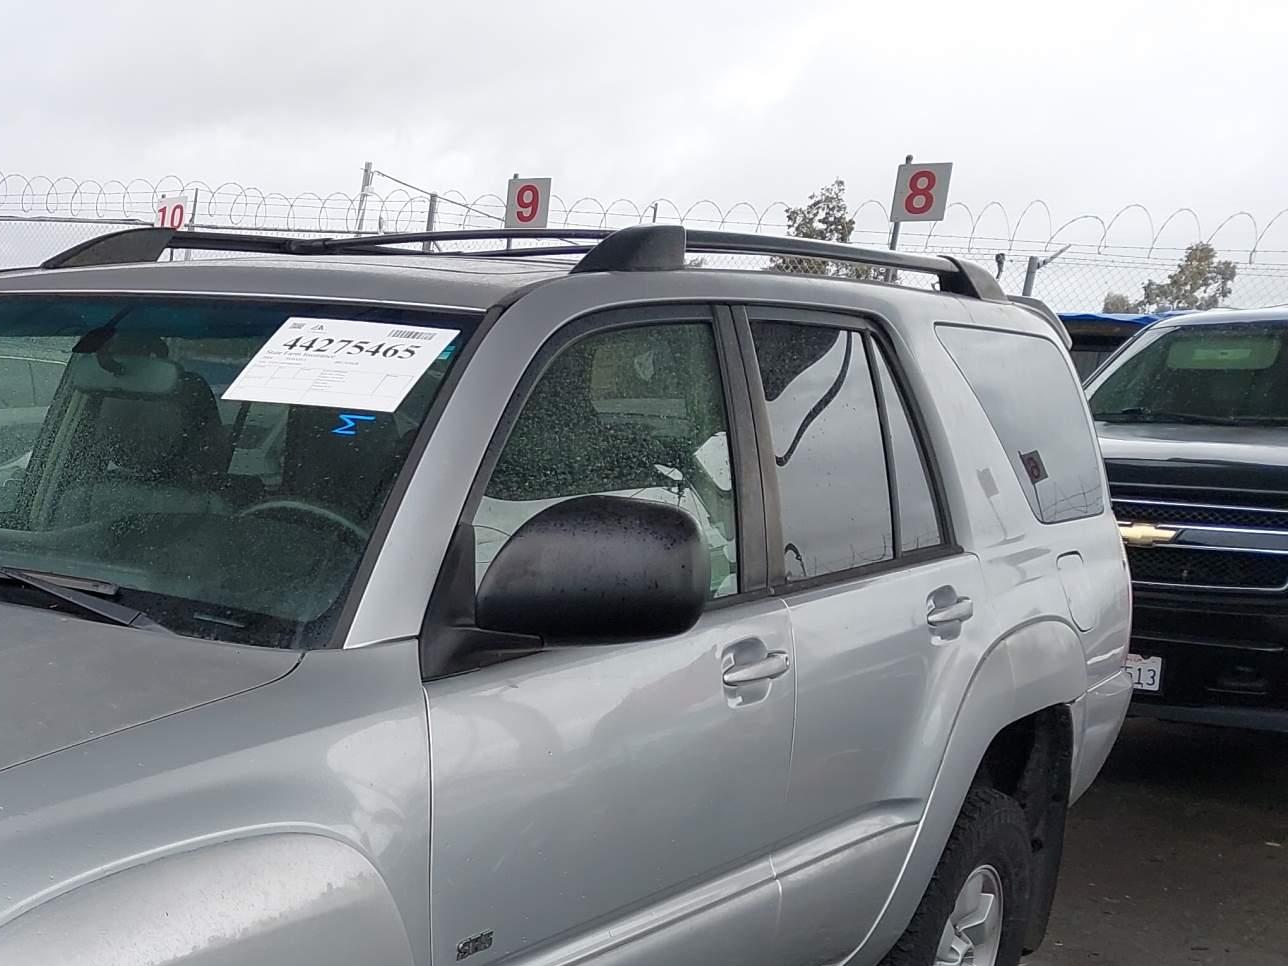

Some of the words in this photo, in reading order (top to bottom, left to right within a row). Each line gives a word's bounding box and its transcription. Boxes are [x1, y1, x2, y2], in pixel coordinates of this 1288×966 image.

[516, 184, 539, 222] 9
[904, 170, 936, 214] 8
[158, 204, 184, 229] 10
[283, 335, 421, 360] 44275465
